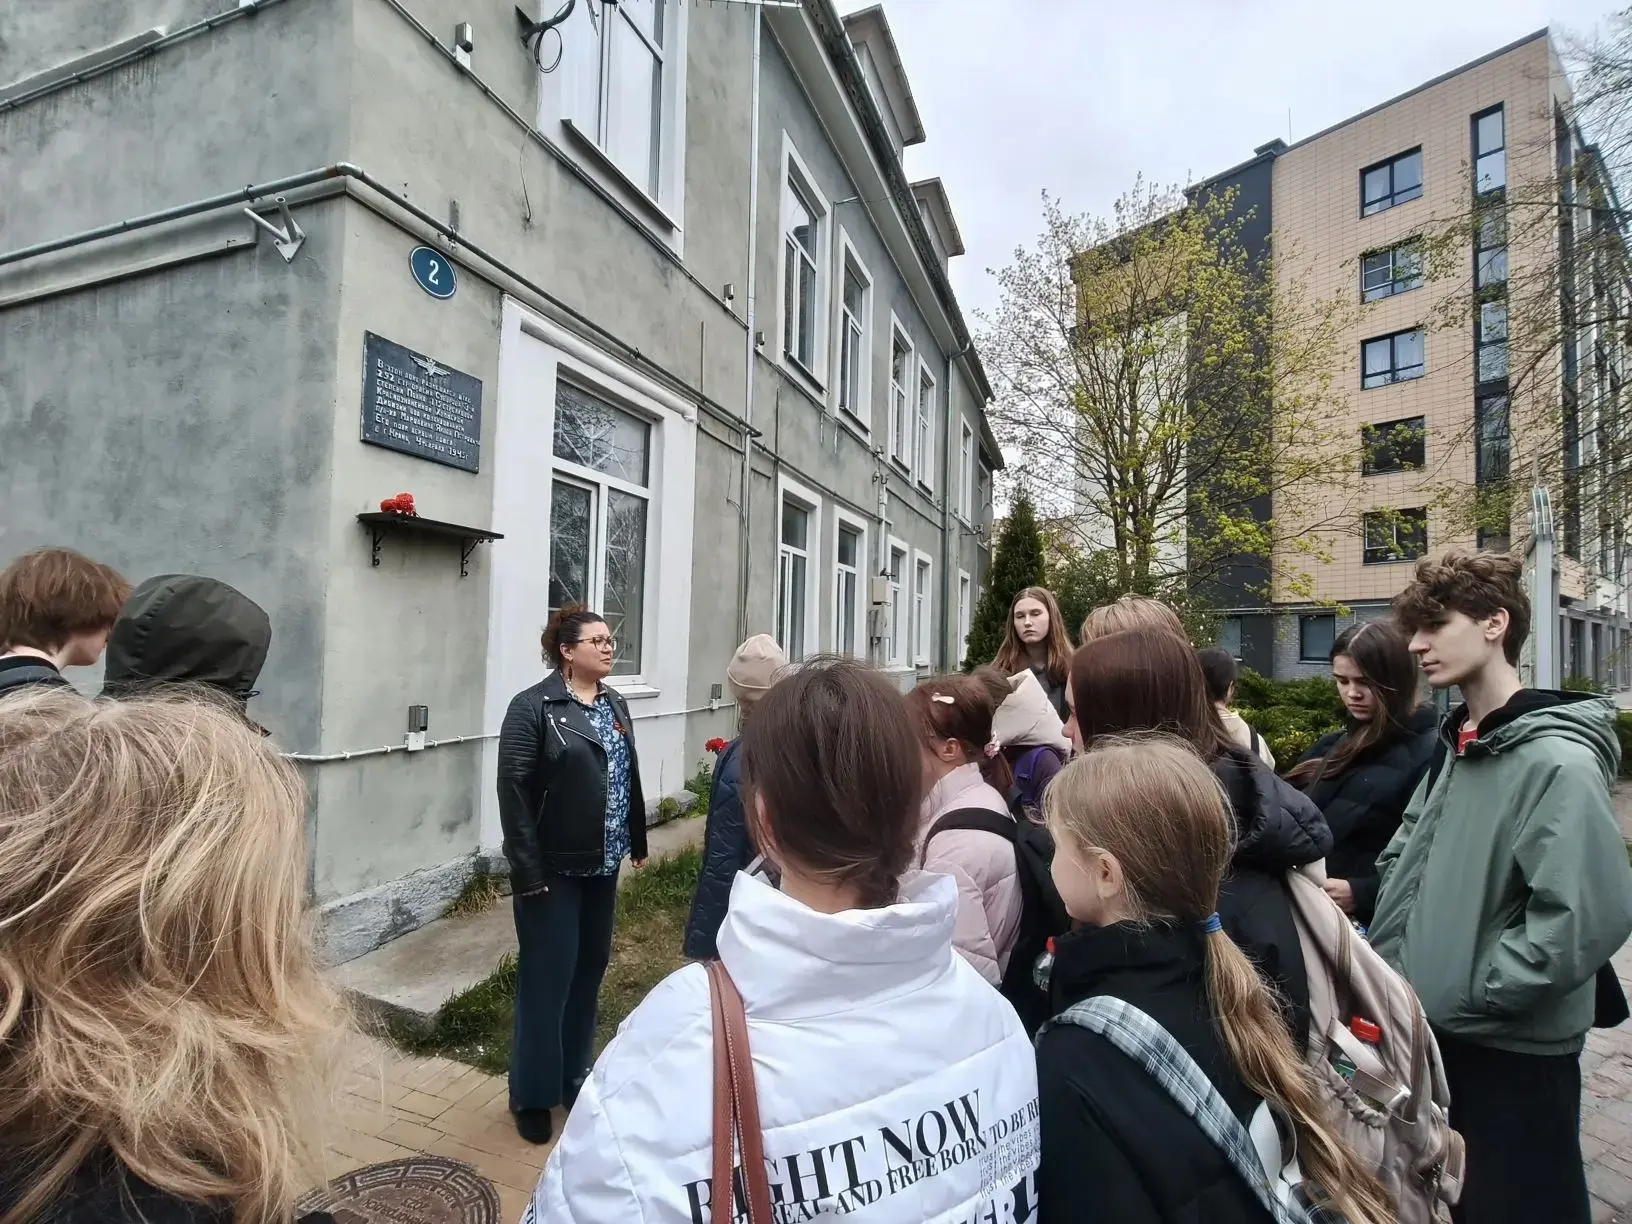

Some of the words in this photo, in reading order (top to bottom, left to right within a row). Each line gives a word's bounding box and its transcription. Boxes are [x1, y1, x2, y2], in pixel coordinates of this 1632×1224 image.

[429, 260, 439, 285] 2
[835, 1179, 882, 1214] AND
[886, 1157, 938, 1195] FREE
[940, 1131, 987, 1172] BORN
[989, 1119, 1007, 1145] TO
[1010, 1108, 1026, 1133] BE
[878, 1088, 979, 1173] NOW
